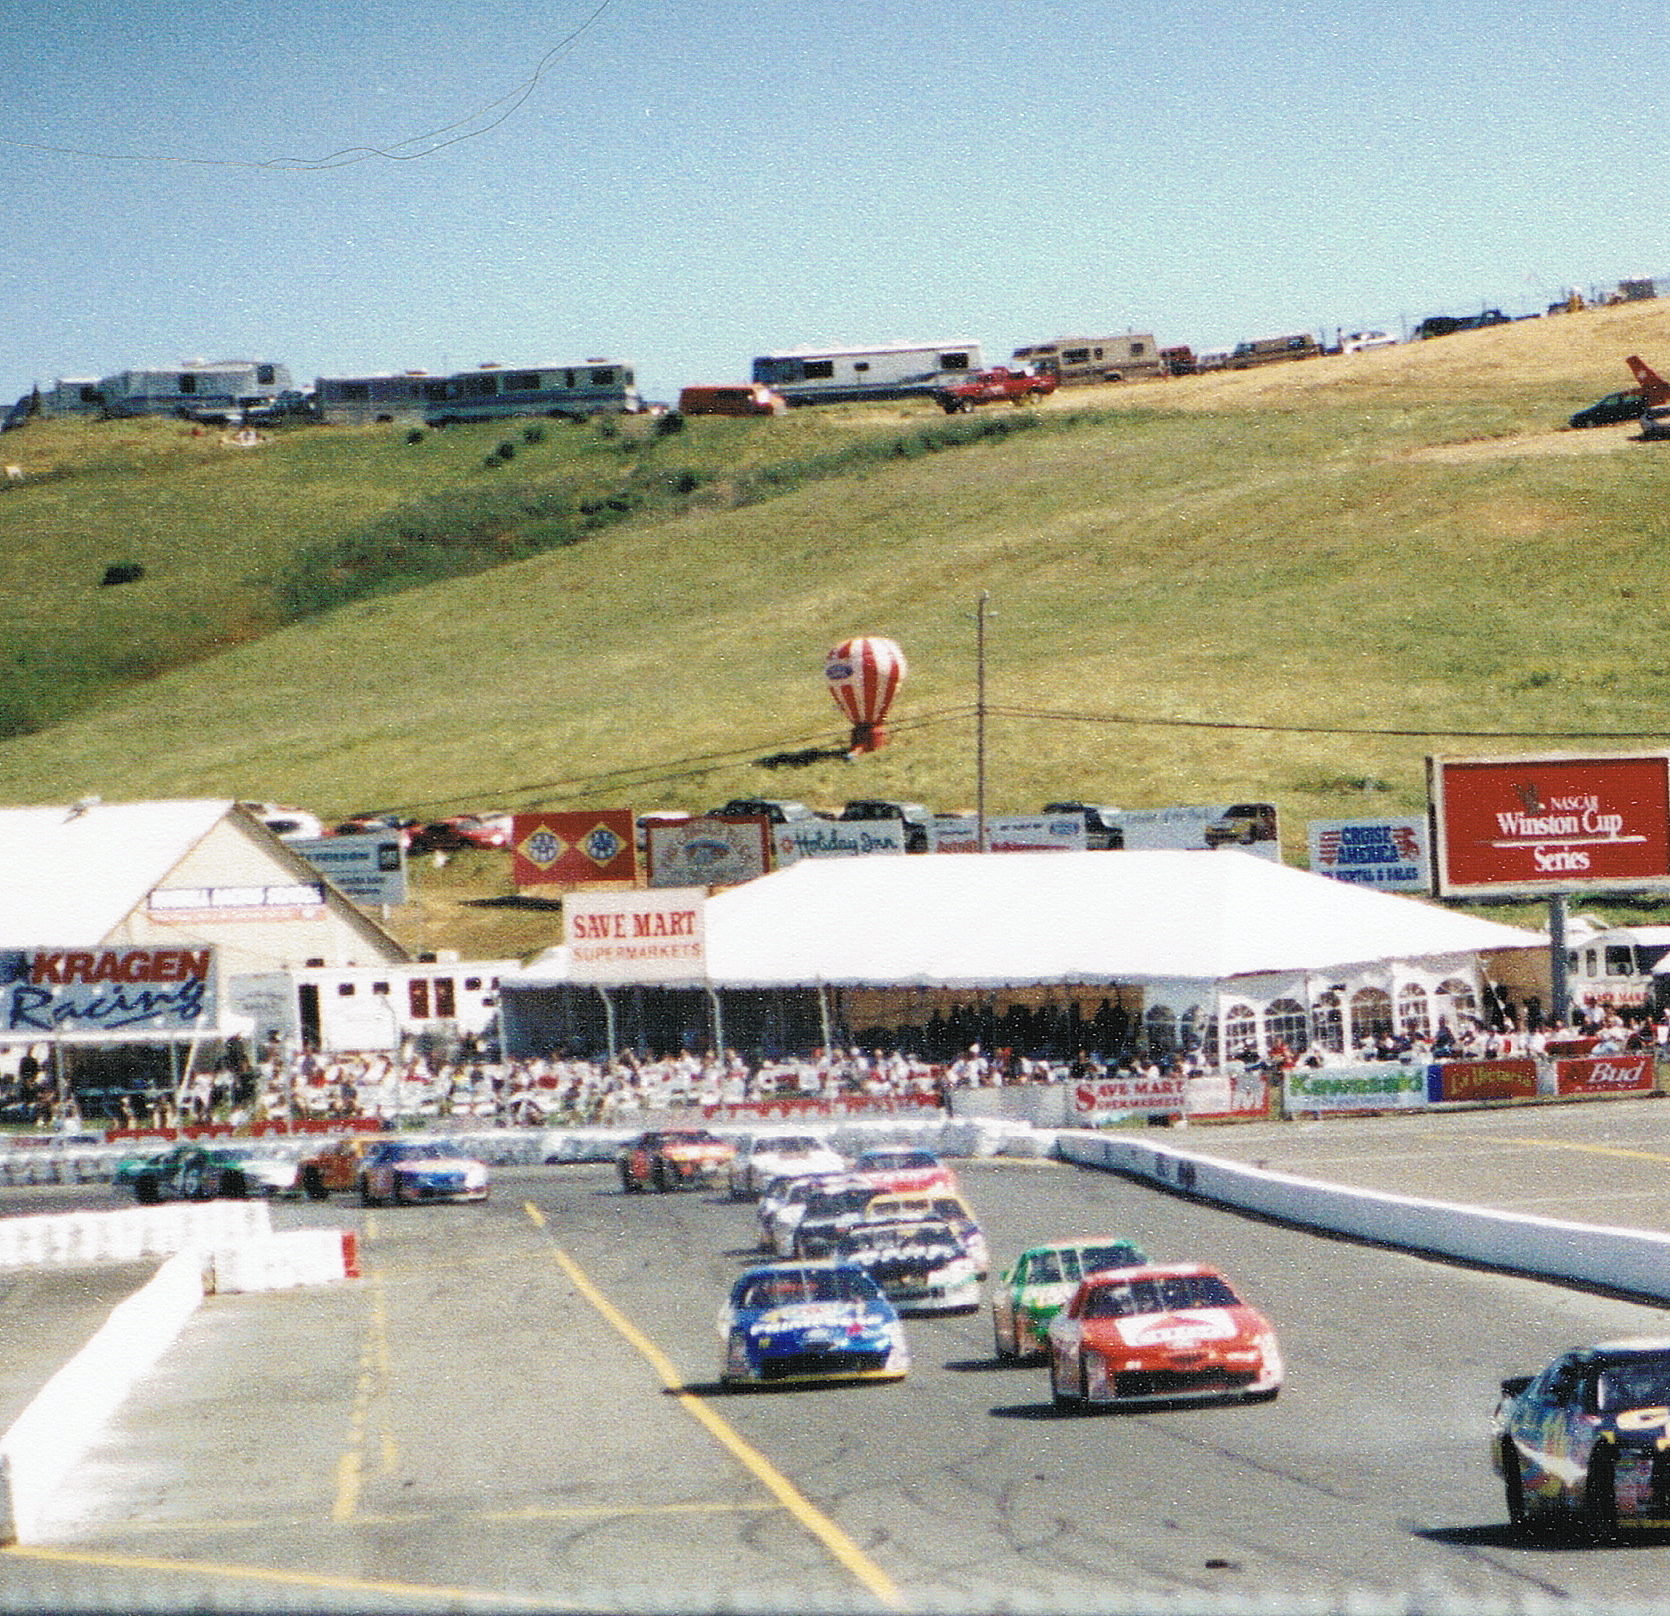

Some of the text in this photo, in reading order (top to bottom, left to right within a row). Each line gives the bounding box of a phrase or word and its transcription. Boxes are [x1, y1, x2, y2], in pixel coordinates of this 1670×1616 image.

[1550, 796, 1598, 811] NASCAR
[1495, 808, 1623, 838] Winston Cup
[793, 828, 898, 856] Holiday Inn
[1340, 826, 1391, 845] CRUISE
[1337, 845, 1400, 864] AMERICA
[1534, 846, 1590, 872] Series
[1386, 868, 1418, 882] SALES
[573, 911, 696, 939] SAVE MART
[572, 943, 703, 963] SUPERMARKETS
[31, 950, 211, 984] KRAGEN
[9, 977, 206, 1031] Racing
[1588, 1060, 1646, 1084] Bud
[1134, 1081, 1184, 1095] MART
